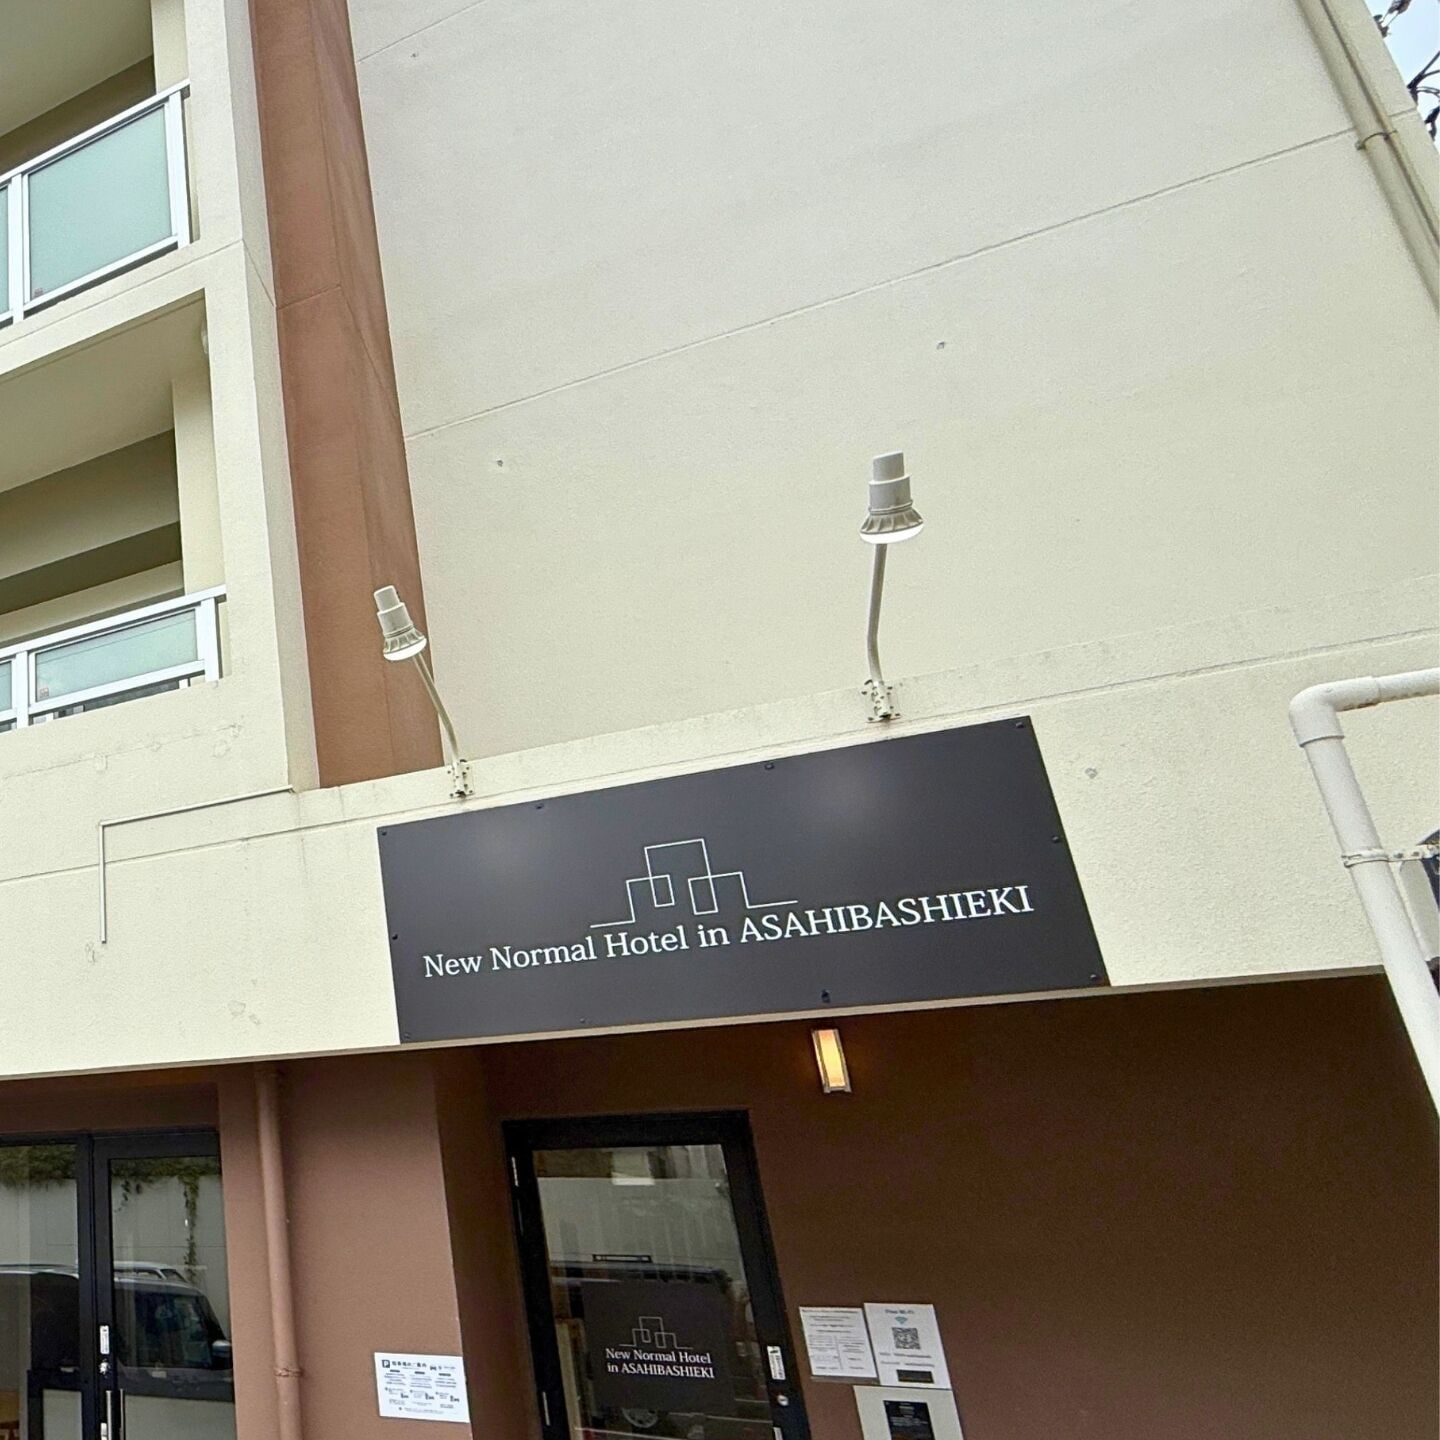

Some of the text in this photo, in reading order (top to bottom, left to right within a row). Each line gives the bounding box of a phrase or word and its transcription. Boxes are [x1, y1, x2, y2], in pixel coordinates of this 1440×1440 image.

[422, 885, 1035, 978] New Normal Hotel in ASAHIBASHIEKI
[605, 1347, 712, 1364] New Normal Hotel
[607, 1362, 715, 1379] in ASAHIBASHIEKI
